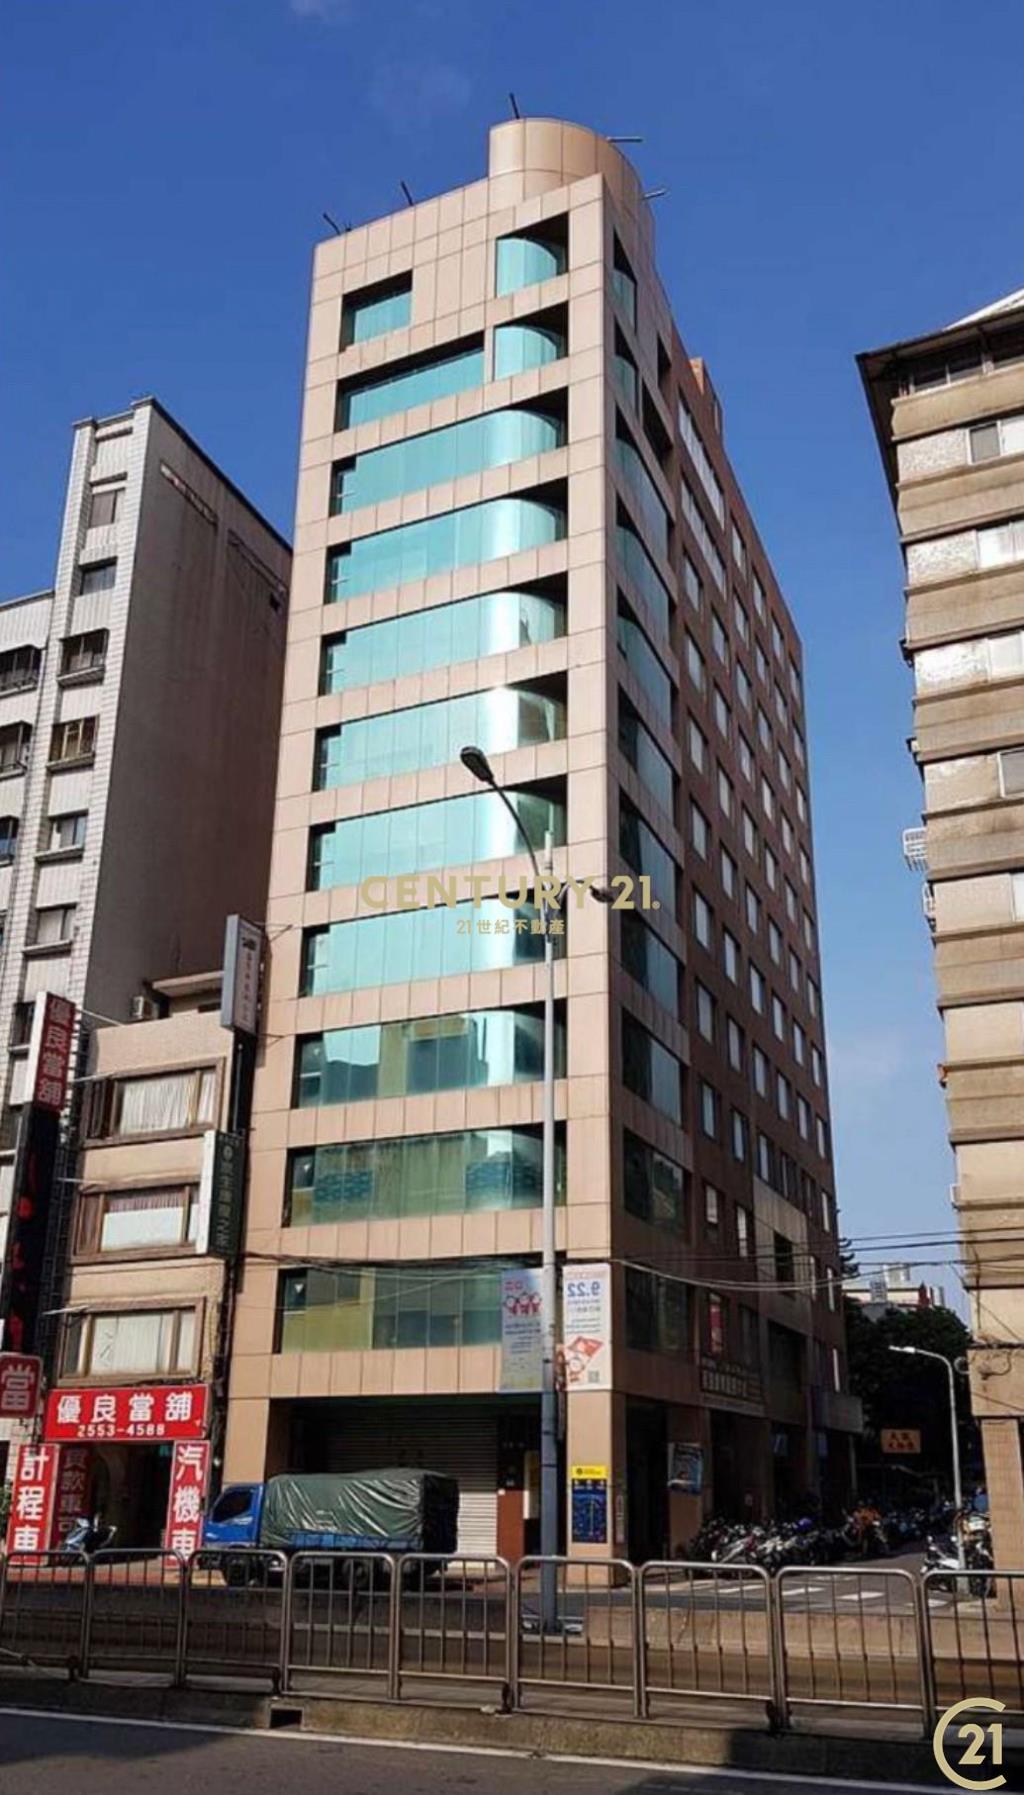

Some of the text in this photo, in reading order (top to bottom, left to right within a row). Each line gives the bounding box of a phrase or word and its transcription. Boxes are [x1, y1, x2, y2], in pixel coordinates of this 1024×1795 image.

[1, 1364, 36, 1411] 當
[13, 1446, 49, 1561] 計程車
[171, 1445, 204, 1561] 汽機車
